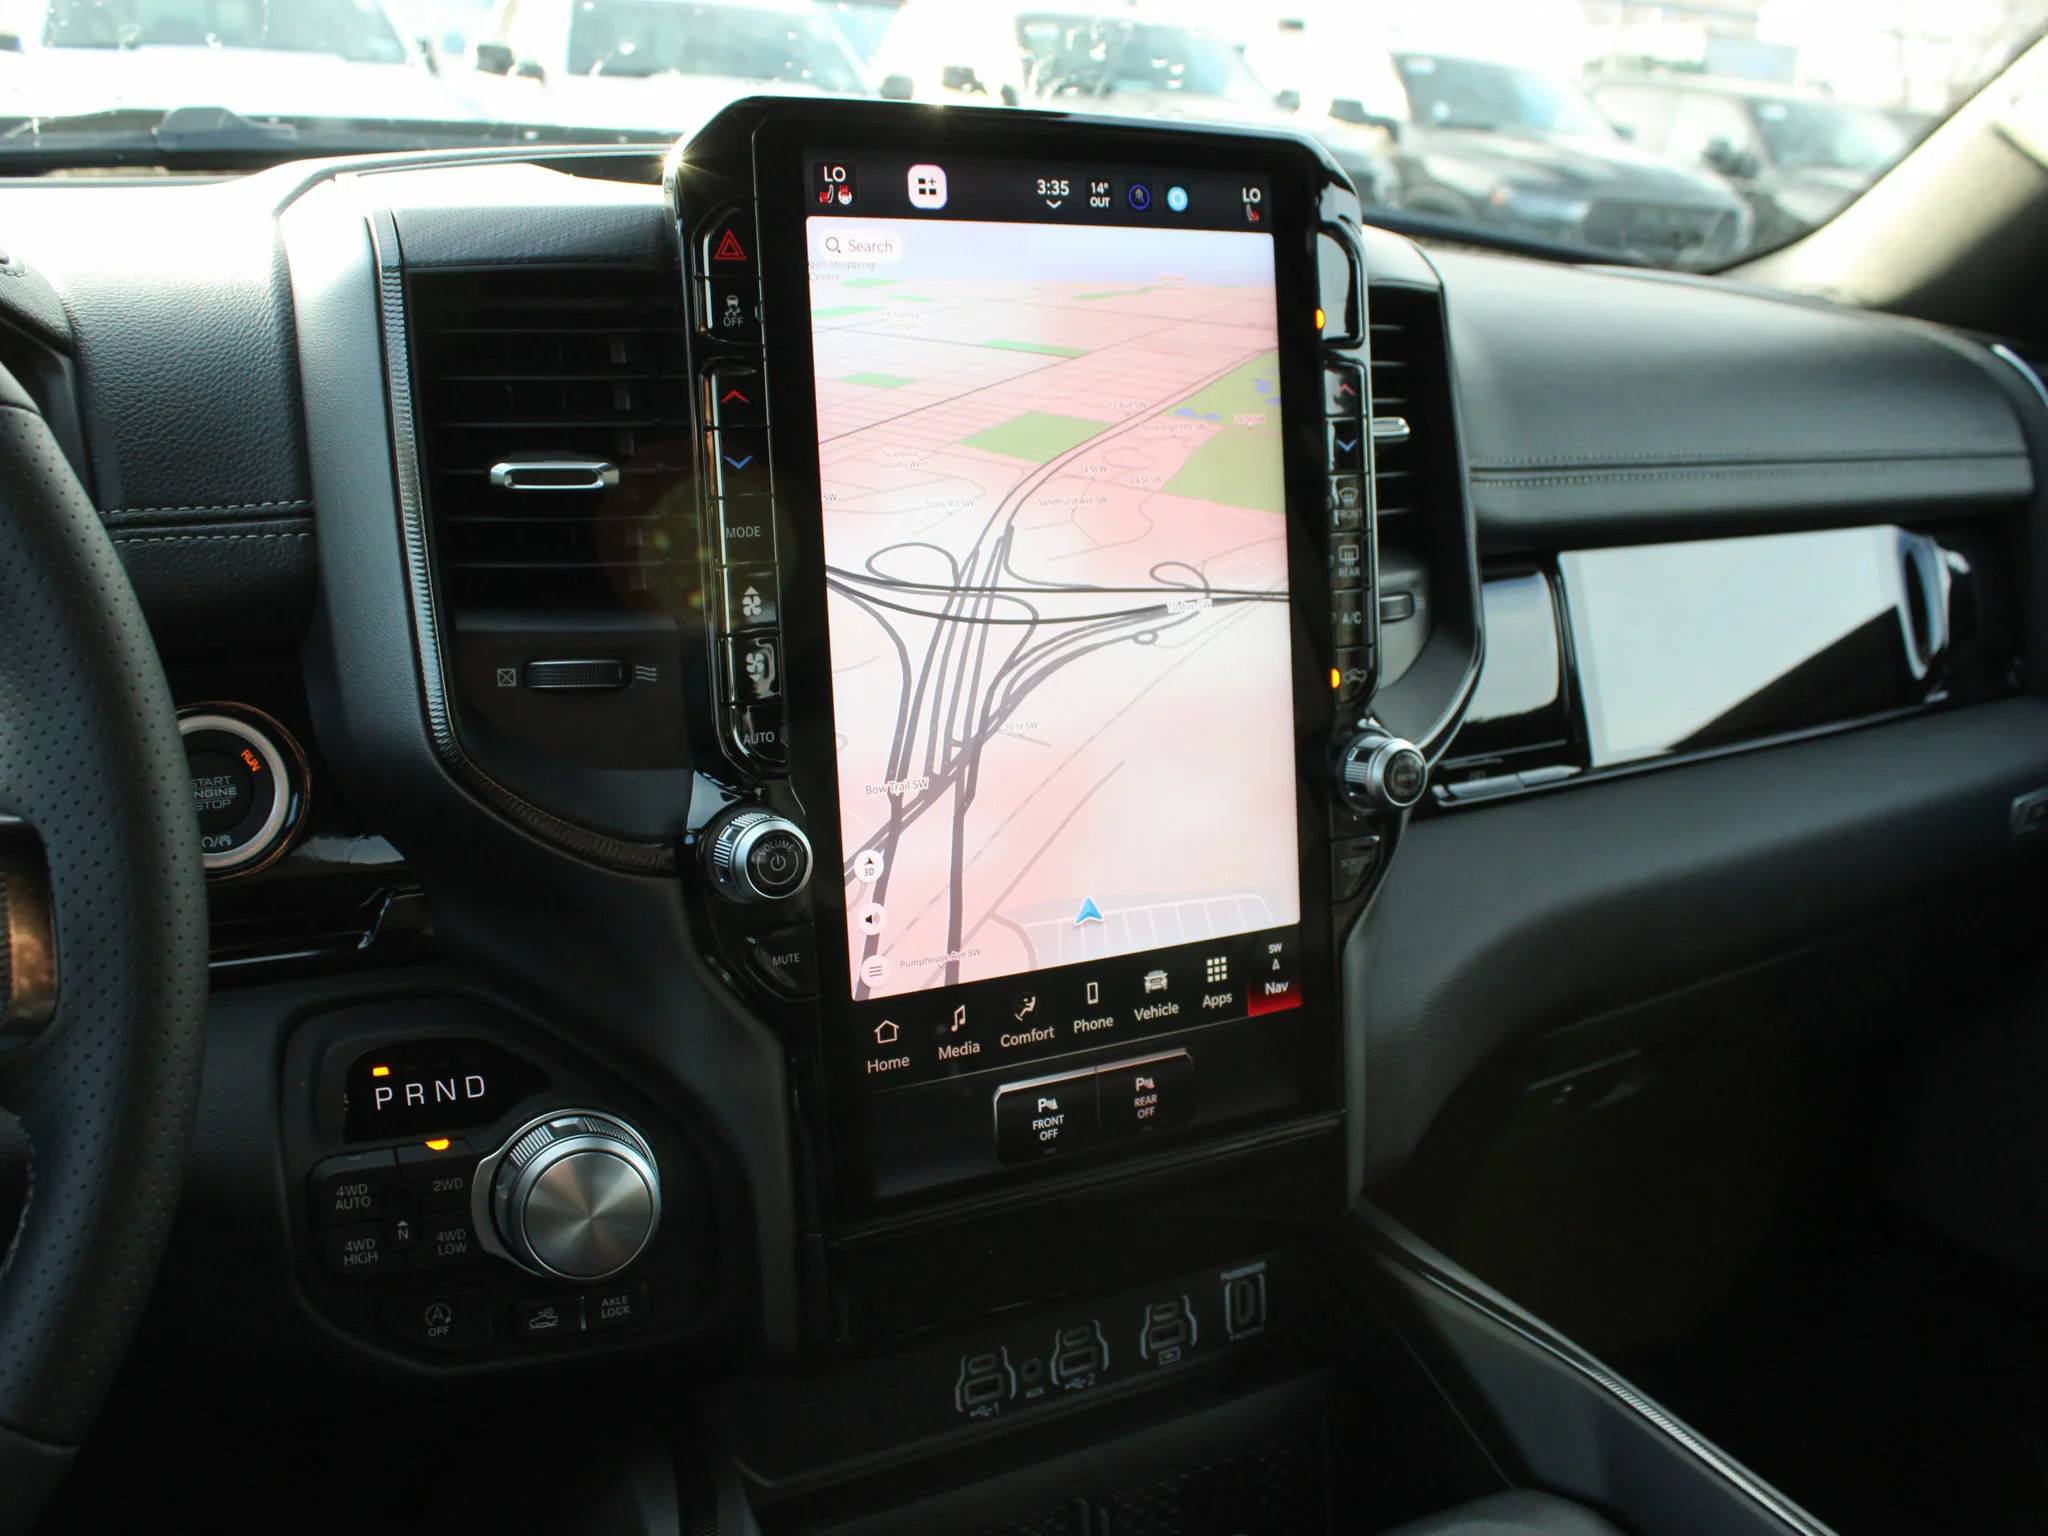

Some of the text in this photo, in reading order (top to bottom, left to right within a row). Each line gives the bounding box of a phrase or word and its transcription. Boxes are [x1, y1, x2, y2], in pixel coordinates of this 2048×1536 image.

[823, 165, 846, 183] LO
[1037, 178, 1070, 196] 3:35
[1090, 196, 1110, 208] OUT
[1242, 187, 1261, 203] LO
[848, 239, 893, 254] Search
[723, 316, 744, 328] OFF
[726, 526, 761, 538] MODE
[1338, 567, 1361, 577] REAR
[1342, 612, 1362, 625] A/C
[1025, 720, 1038, 730] SW
[743, 731, 775, 745] AUTO
[240, 749, 261, 772] RUN
[194, 786, 237, 798] NGINE
[865, 778, 928, 795] Bow Trail SW
[758, 839, 795, 856] VOLUME
[864, 867, 875, 877] 3D
[772, 953, 800, 966] MUTE
[900, 948, 981, 969] Pumphouse Ave SW
[1265, 981, 1289, 995] Nav
[1202, 992, 1232, 1009] Apps
[1134, 1002, 1180, 1021] Vehicle
[1073, 1016, 1114, 1033] Phone
[1000, 1026, 1055, 1047] Comfort
[938, 1041, 980, 1060] Media
[867, 1055, 910, 1074] Home
[1134, 1094, 1157, 1107] REAR
[1137, 1106, 1156, 1119] OFF
[1032, 1114, 1065, 1130] FRONT
[1039, 1128, 1058, 1141] OFF
[335, 1183, 369, 1197] 4WD
[432, 1177, 464, 1192] 2WD
[335, 1196, 371, 1212] AUTO
[398, 1228, 409, 1240] N
[436, 1228, 467, 1242] 4WD
[344, 1238, 376, 1252] 4WD
[437, 1241, 467, 1256] LOW
[343, 1251, 378, 1266] HIGH
[601, 1294, 628, 1308] AXLE
[601, 1306, 631, 1319] LOCK
[428, 1325, 450, 1338] OFF
